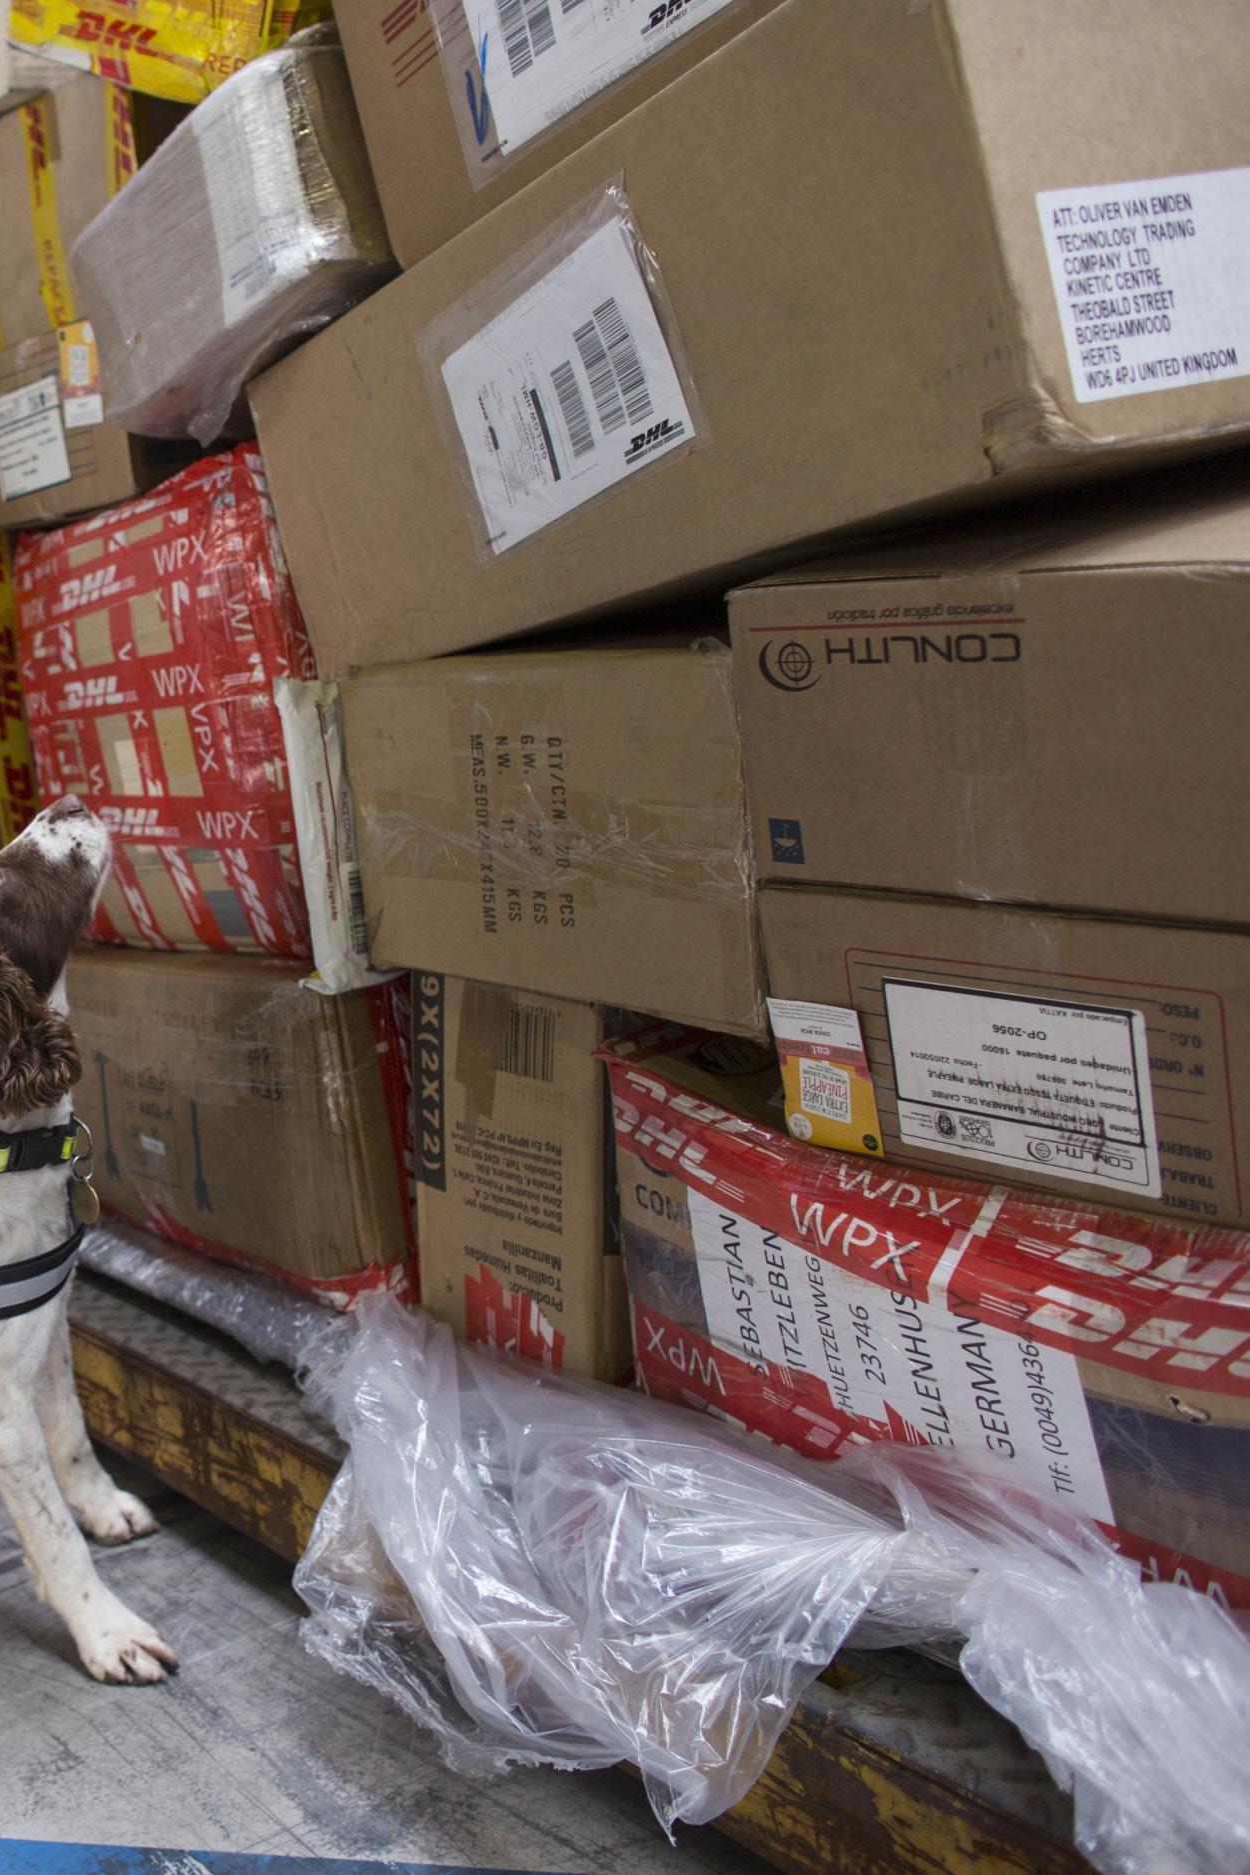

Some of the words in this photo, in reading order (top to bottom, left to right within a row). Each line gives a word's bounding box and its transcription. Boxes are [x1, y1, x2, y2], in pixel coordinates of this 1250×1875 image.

[76, 9, 159, 58] DHL
[1053, 208, 1078, 229] ATT:
[1079, 202, 1122, 225] OLIVER
[1124, 199, 1149, 219] VAN
[1150, 193, 1193, 216] EMDEN
[1057, 226, 1137, 253] TECHNOLOGY
[1143, 219, 1195, 243] TRADING
[1063, 252, 1122, 275] COMPANY
[1127, 248, 1150, 268] LTD
[1066, 274, 1113, 298] KINETIC
[1115, 268, 1163, 290] CENTRE
[1071, 297, 1132, 322] THEOBALD
[1133, 290, 1175, 314] STREET
[1075, 314, 1171, 345] BOREHAMWOOD
[1081, 345, 1121, 367] HERTS
[1086, 371, 1113, 390] WD6
[1139, 357, 1180, 380] UNITED
[1183, 348, 1238, 375] KINGDOM
[628, 418, 674, 453] DHL
[152, 530, 209, 577] WPX
[59, 564, 123, 611] DHL
[827, 609, 878, 624] tradición
[879, 605, 901, 620] por
[825, 633, 1022, 664] CONLITH
[63, 675, 125, 710] DHL
[152, 664, 205, 699] WPX
[99, 806, 166, 837] DHL
[196, 811, 259, 840] WPX
[495, 735, 511, 775] N.W.
[506, 888, 523, 924] KGS
[520, 734, 536, 775] G.W.
[532, 889, 548, 927] KGS
[558, 893, 575, 930] PCS
[992, 1023, 1047, 1041] OP-2056
[1016, 1049, 1057, 1063] paquete
[1060, 1055, 1078, 1066] por
[1079, 1057, 1132, 1076] Unidades
[417, 975, 441, 1171] 9X(2X72)
[802, 1075, 849, 1100] PINEAPPLE
[967, 1077, 994, 1089] LARGE
[802, 1088, 826, 1107] LARGE
[931, 1089, 960, 1102] CARIBE
[962, 1094, 978, 1105] DEL
[996, 1082, 1022, 1095] EXTRA
[1053, 1092, 1096, 1108] ETIQUETA
[825, 1096, 849, 1114] EXTRA
[979, 1098, 1026, 1115] BANANERA
[1026, 1106, 1077, 1124] INDUSTRIAL
[1099, 1100, 1138, 1116] Producto
[530, 1204, 541, 1215] de
[541, 1194, 562, 1209] Zona
[835, 1163, 963, 1227] WPX
[791, 1192, 922, 1282] WPX
[463, 1245, 512, 1275] Húmedas
[501, 1239, 562, 1272] Manzanilla
[514, 1263, 563, 1293] Toallitas
[719, 1214, 770, 1378] SEBASTIAN
[642, 1317, 727, 1397] WPX
[849, 1303, 887, 1386] 23746
[949, 1290, 1016, 1459] GERMANY
[1054, 1461, 1076, 1495] Tlf:
